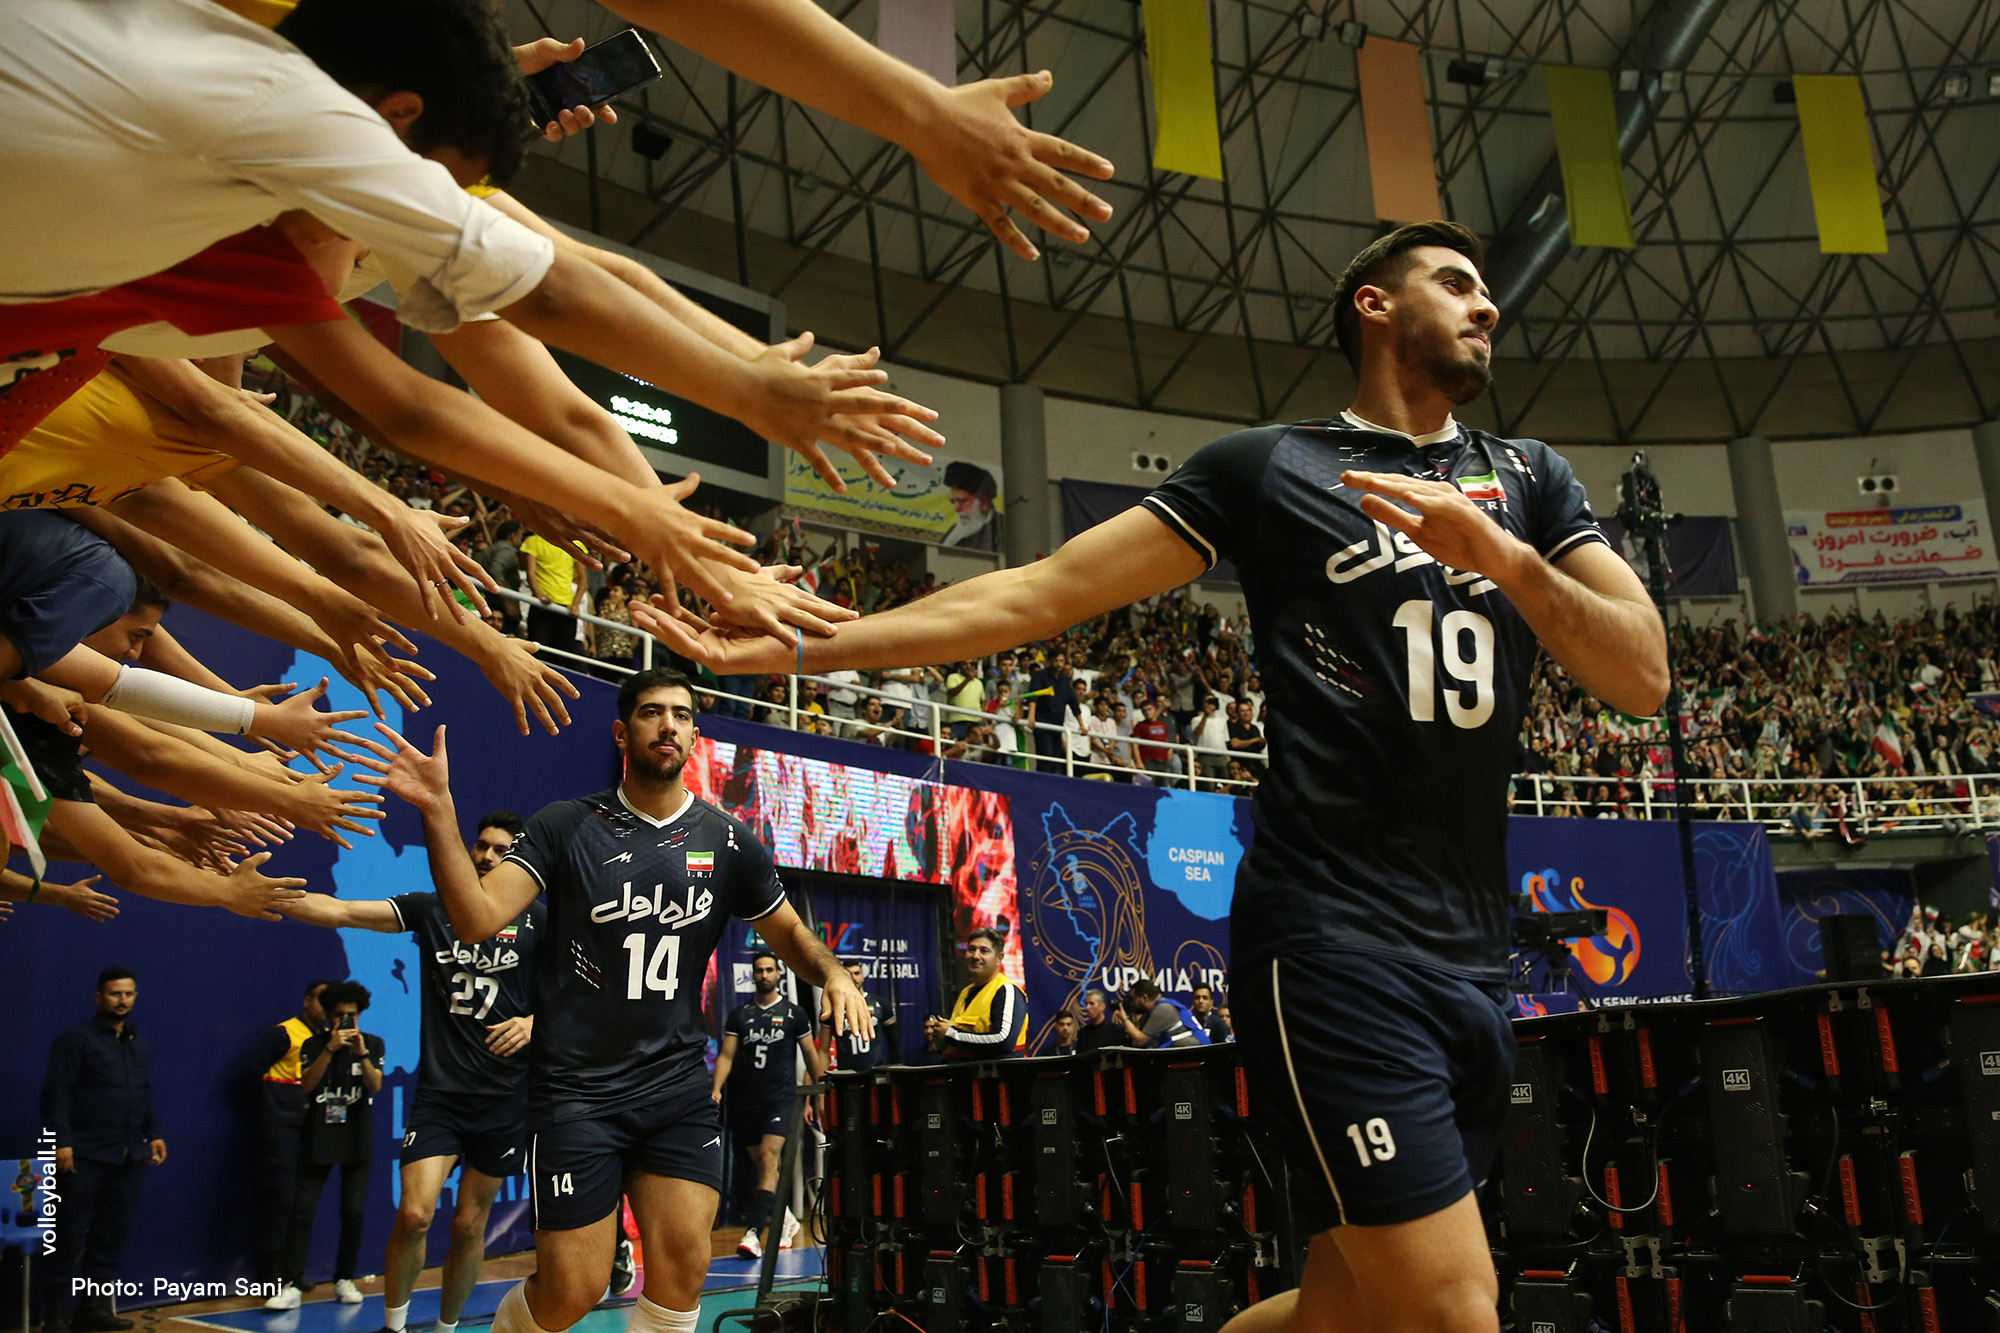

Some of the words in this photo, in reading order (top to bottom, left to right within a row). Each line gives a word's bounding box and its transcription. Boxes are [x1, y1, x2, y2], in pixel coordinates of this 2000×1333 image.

[1869, 526, 1938, 547] ضرورت
[1818, 551, 1885, 573] فردا
[1889, 544, 1983, 566] ضمانت
[1392, 599, 1496, 730] 19
[1168, 847, 1225, 865] CASPIAN
[1185, 866, 1212, 882] SEA
[622, 932, 681, 1001] 14
[449, 971, 499, 1020] 27
[848, 1033, 870, 1055] 10
[754, 1045, 768, 1069] 5
[1726, 1072, 1747, 1084] 4K
[1512, 1086, 1530, 1097] 4K
[929, 1116, 939, 1124] 4K
[1043, 1111, 1055, 1119] 4K
[1176, 1105, 1190, 1114] 4K
[1346, 1117, 1397, 1168] 19
[551, 1172, 575, 1198] 14
[1188, 1307, 1201, 1316] 4K
